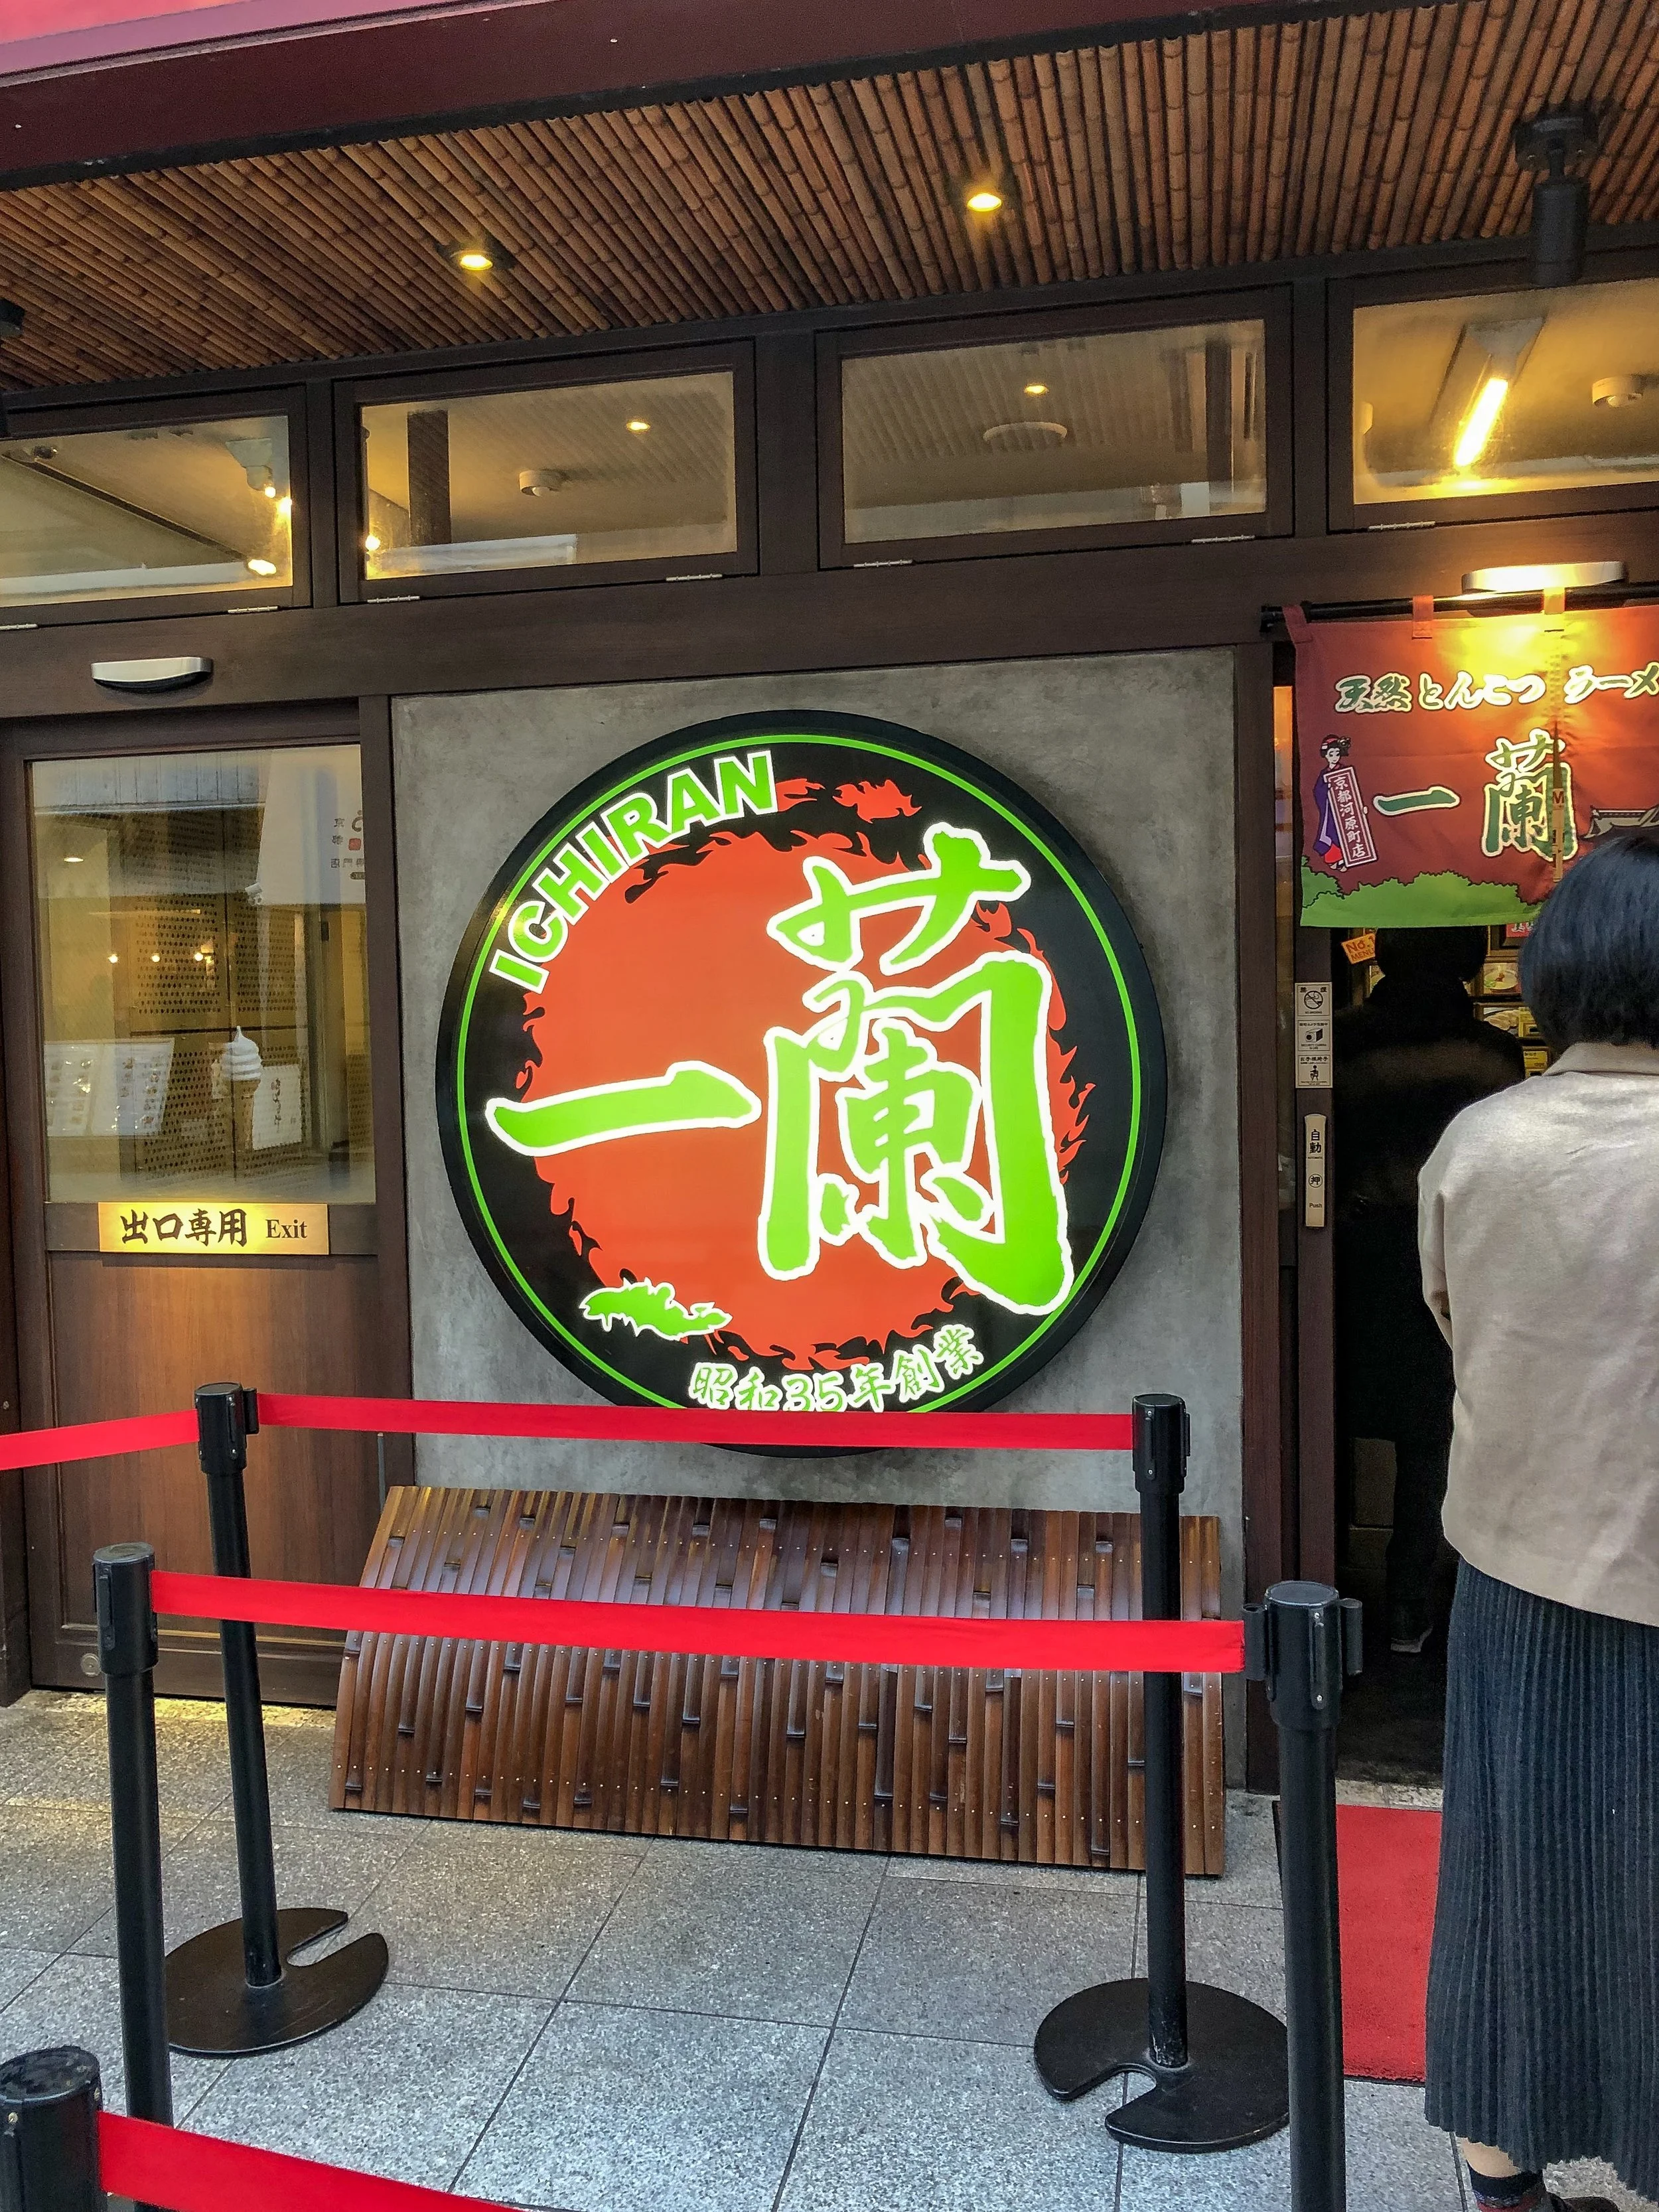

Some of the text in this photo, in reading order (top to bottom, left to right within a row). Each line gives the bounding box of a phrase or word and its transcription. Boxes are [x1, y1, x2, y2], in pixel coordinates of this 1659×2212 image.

[1334, 775, 1366, 858] 京都河原町店
[1372, 727, 1579, 861] 一蘭
[489, 750, 778, 994] ICHIRAN
[486, 822, 1074, 1315] 一蘭
[1309, 1129, 1322, 1154] 自動
[1310, 1176, 1321, 1185] 押
[120, 1209, 307, 1247] 出口専用 Exit
[689, 1323, 984, 1413] 昭和35年創業
